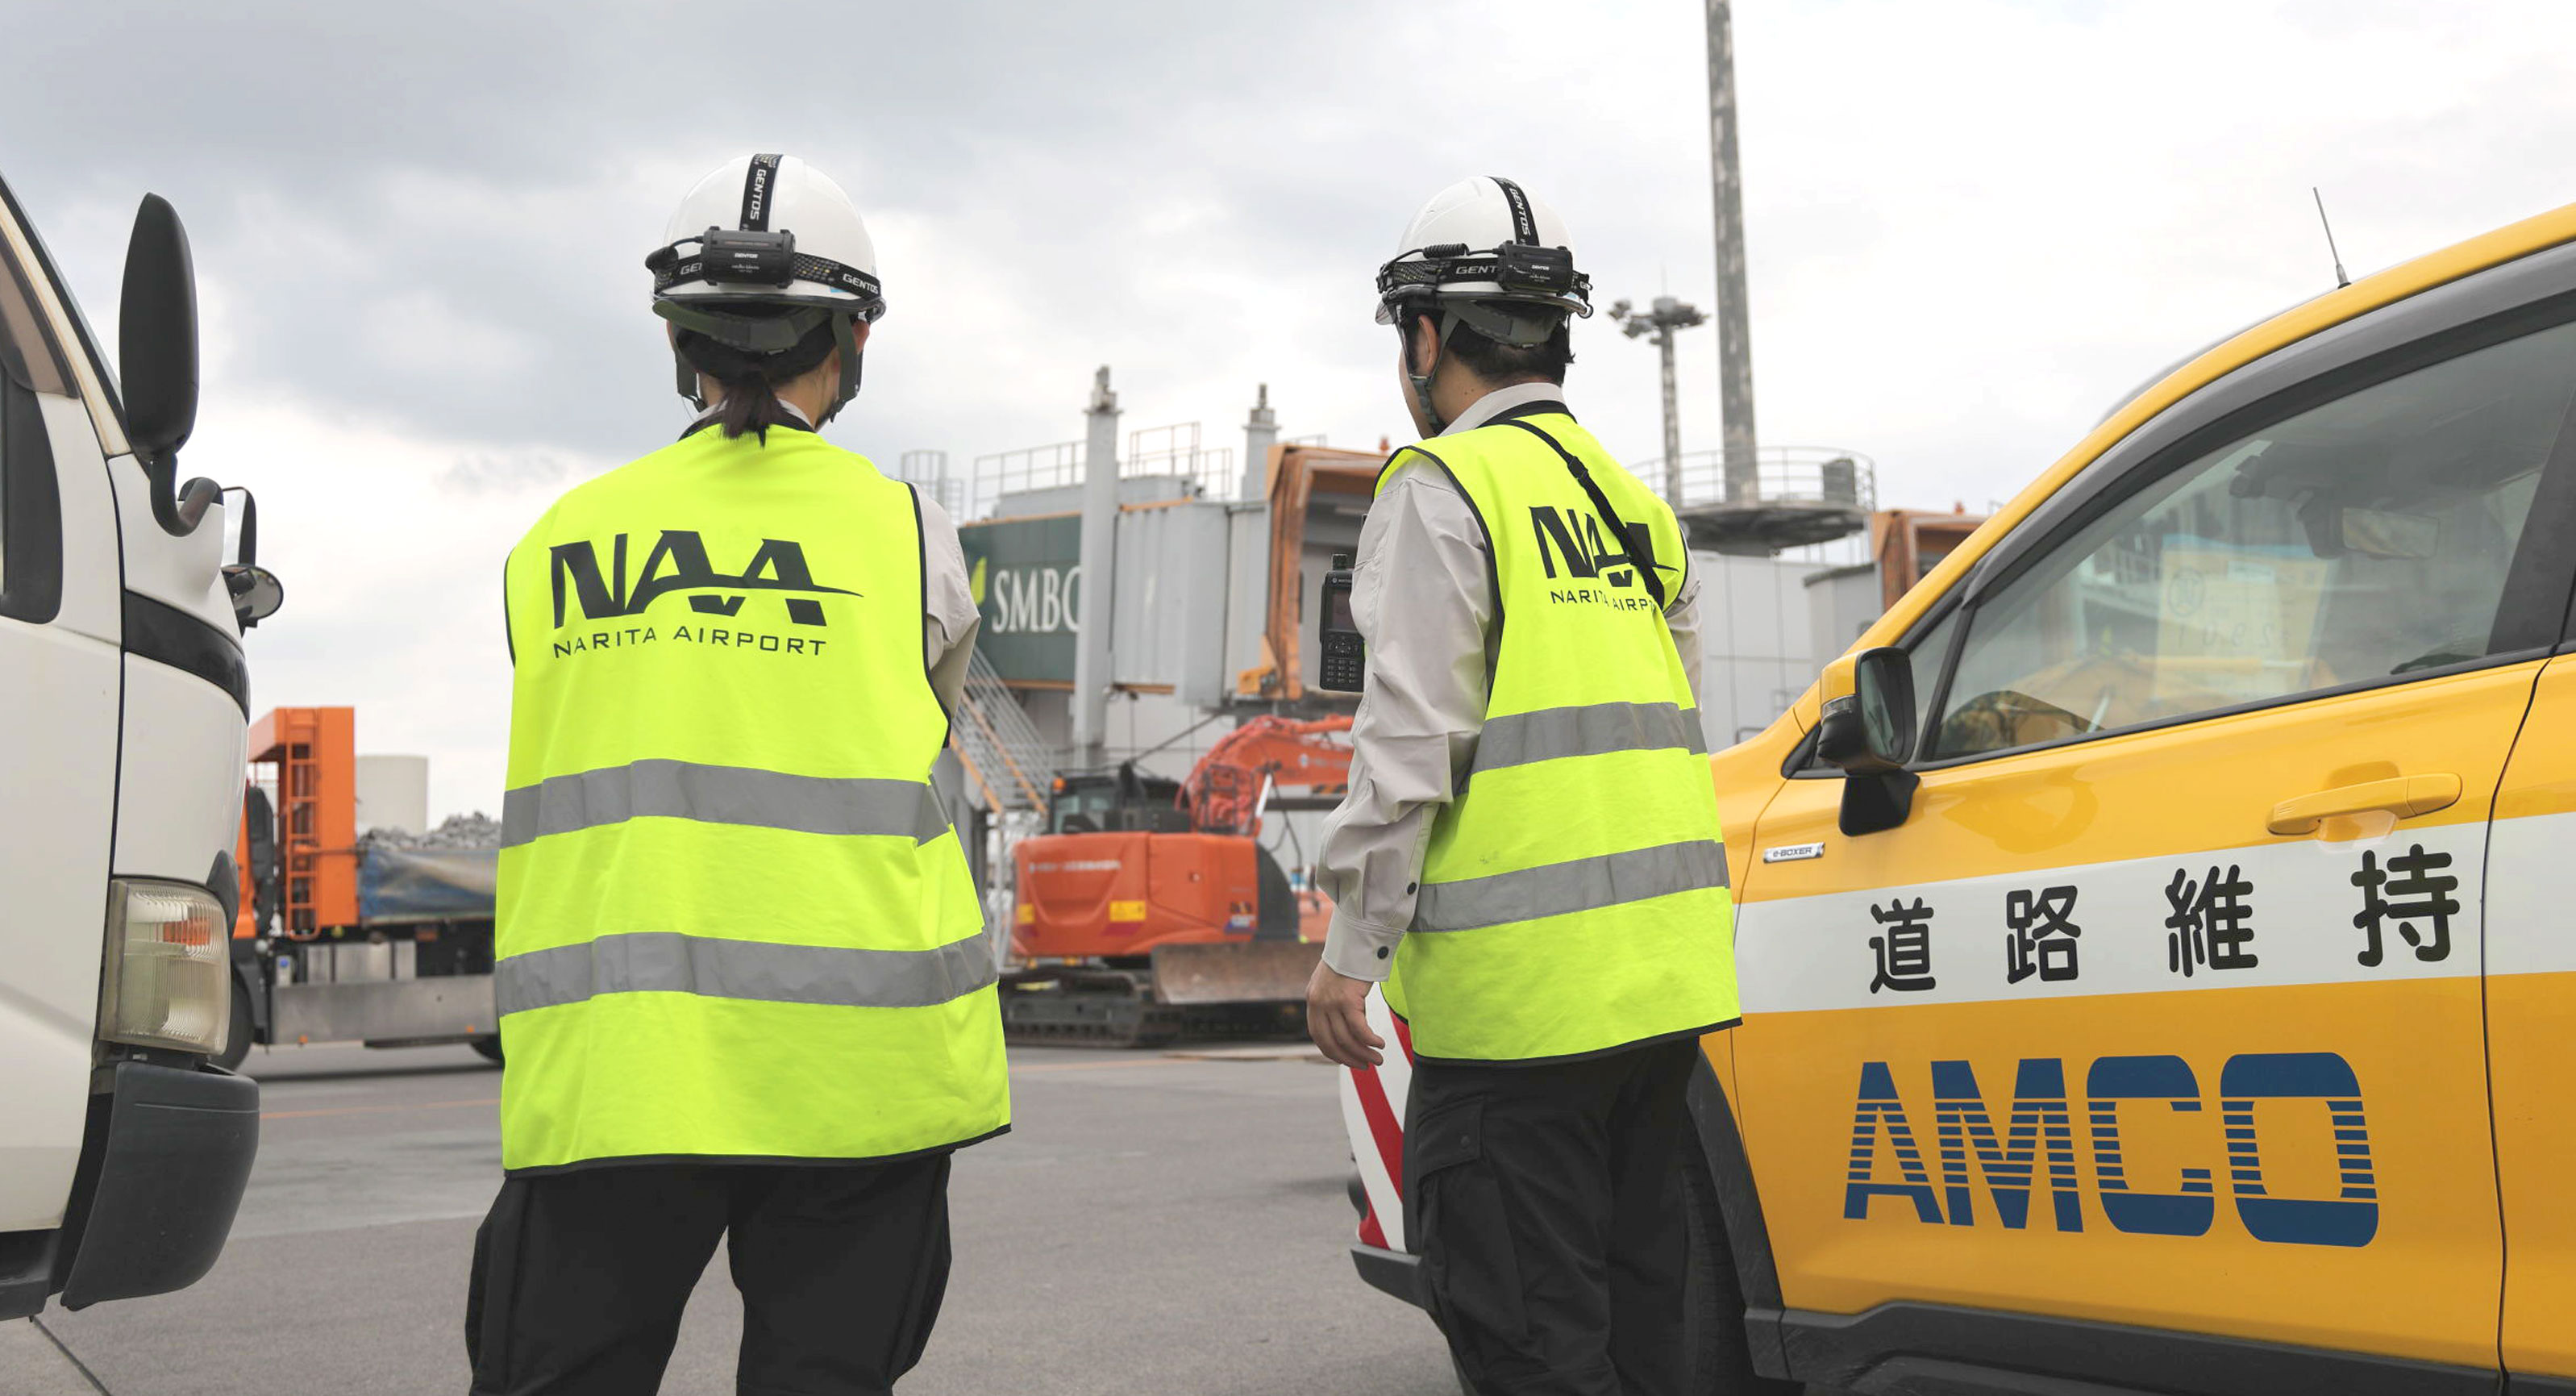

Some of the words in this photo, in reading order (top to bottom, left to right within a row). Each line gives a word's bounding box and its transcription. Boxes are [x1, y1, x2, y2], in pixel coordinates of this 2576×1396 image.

[750, 169, 767, 220] GENTOS
[1509, 187, 1531, 236] GENTOS
[680, 262, 702, 275] GE
[843, 273, 879, 295] GENTOS
[549, 530, 864, 630] NAA
[553, 627, 657, 659] NARITA
[673, 625, 827, 656] AIRPORT
[1772, 847, 1812, 858] e-BOXER
[1869, 844, 2460, 994] 道路維持
[1843, 1052, 2379, 1248] AMCO
